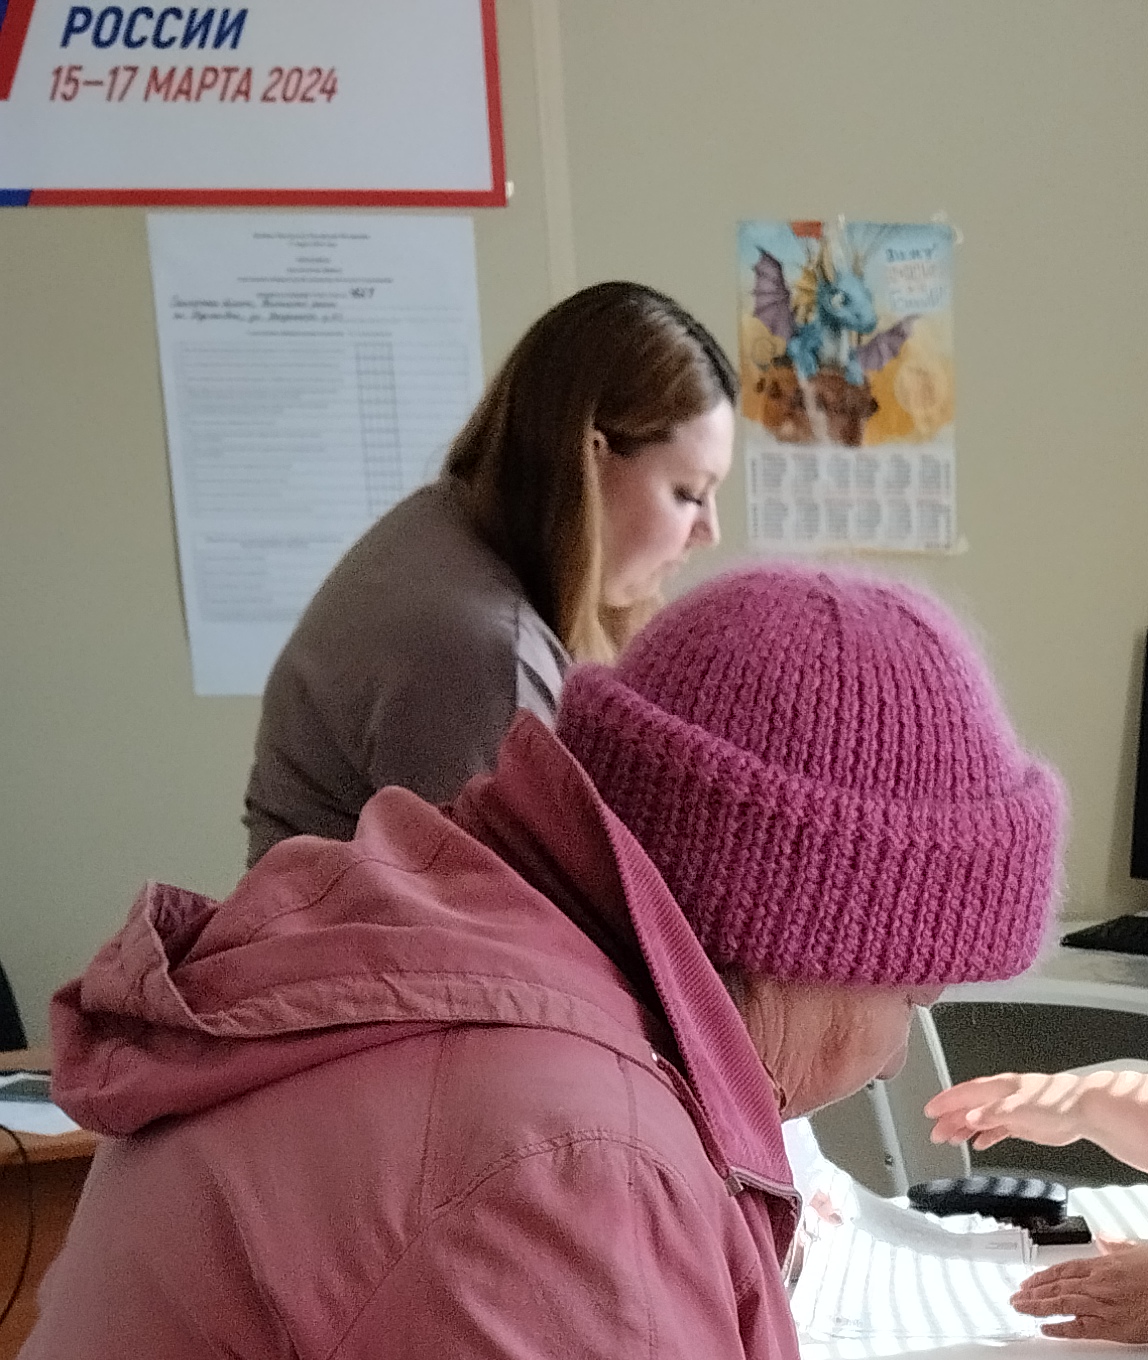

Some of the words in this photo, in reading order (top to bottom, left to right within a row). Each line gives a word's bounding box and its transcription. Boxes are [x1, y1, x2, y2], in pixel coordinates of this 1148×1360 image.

[60, 5, 249, 50] РОССИИ
[143, 66, 253, 102] МАРТА
[260, 66, 338, 103] 2024
